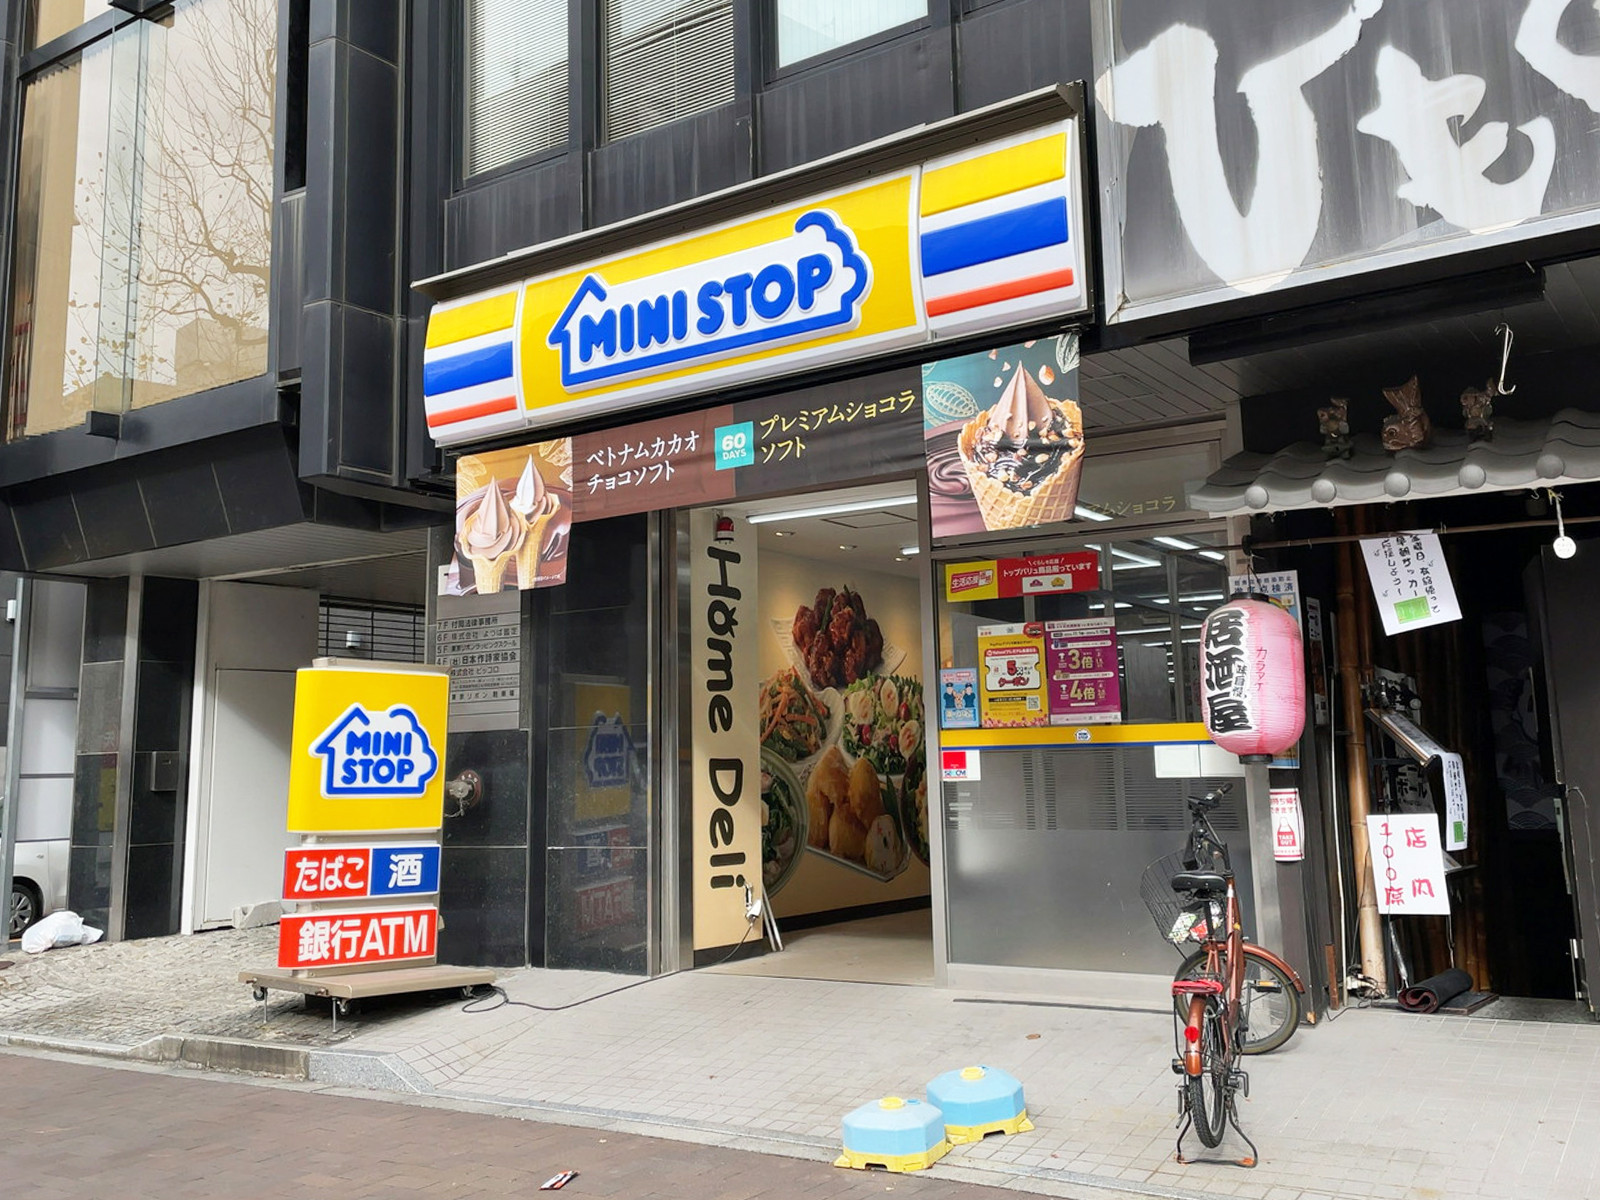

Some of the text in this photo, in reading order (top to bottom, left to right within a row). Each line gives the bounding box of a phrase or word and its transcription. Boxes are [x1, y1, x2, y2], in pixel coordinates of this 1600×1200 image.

[579, 252, 833, 364] MINI STOP
[760, 390, 916, 435] プレミアムショコラ
[586, 430, 700, 467] ベトナムカカオ
[720, 432, 747, 451] 60
[722, 447, 747, 460] DAYS
[760, 436, 807, 464] ソフト
[587, 463, 676, 495] チョコソフト
[437, 632, 448, 642] 6F
[437, 644, 448, 655] 5F
[1205, 610, 1253, 734] 居酒屋
[346, 731, 412, 757] MINI
[341, 757, 415, 785] STOP
[709, 757, 747, 889] Deli
[294, 855, 365, 893] たばこ
[388, 853, 424, 889] 酒
[1404, 828, 1435, 899] 店内
[297, 914, 429, 963] 銀行ATM
